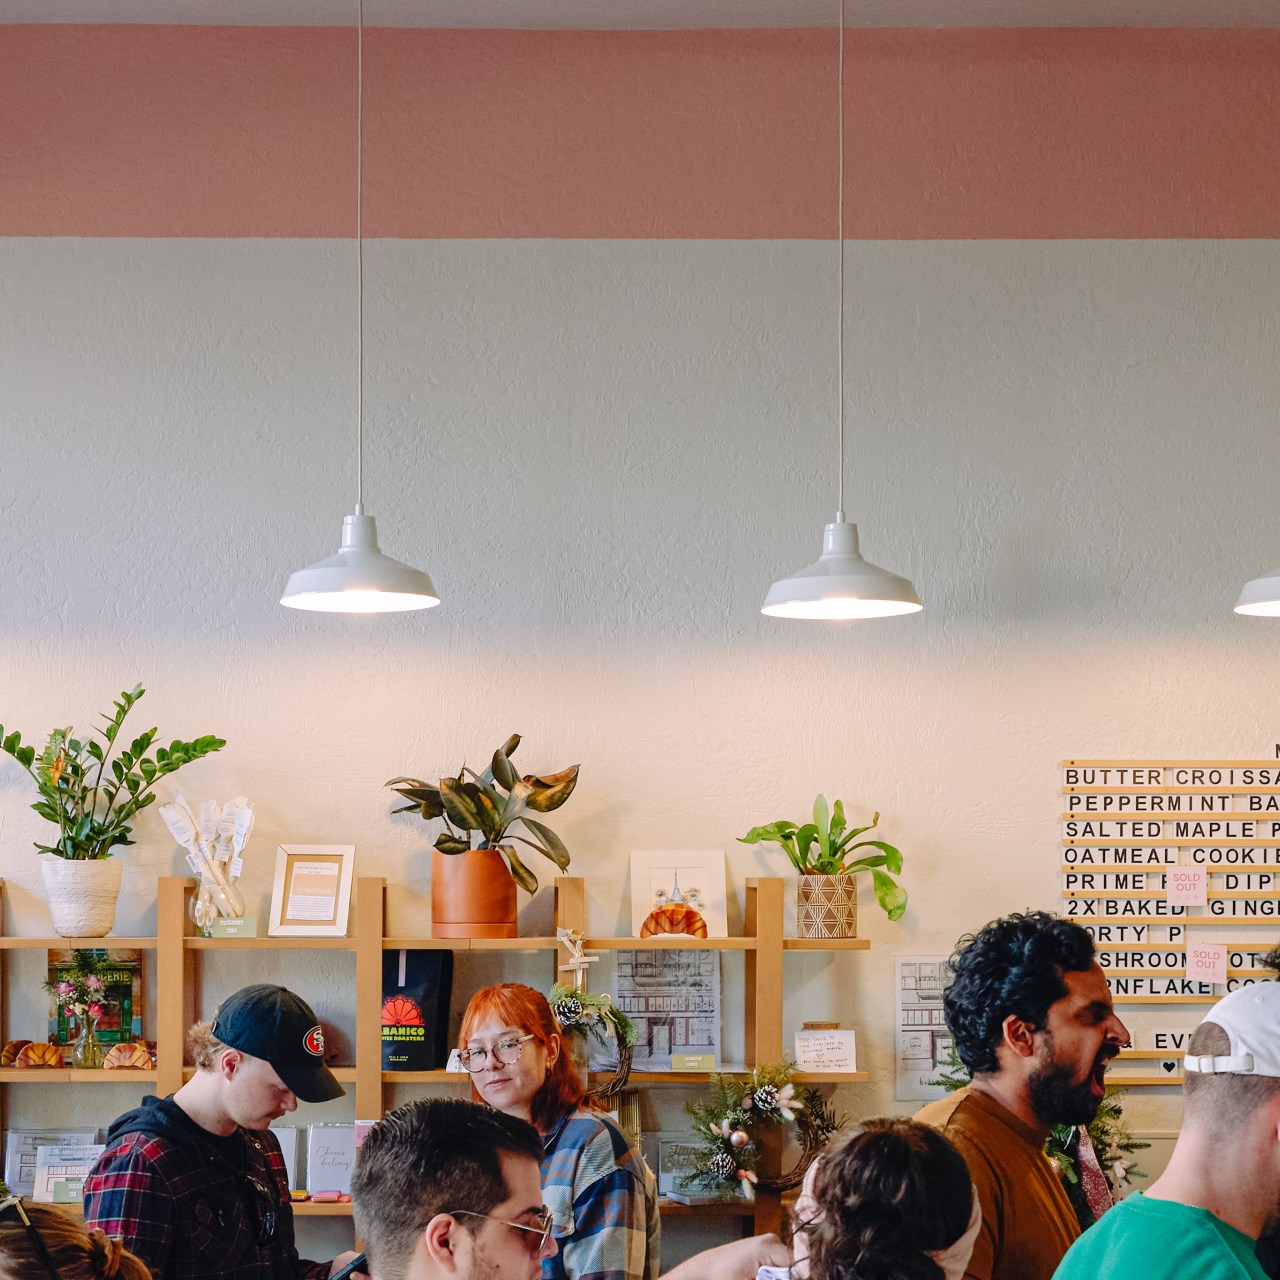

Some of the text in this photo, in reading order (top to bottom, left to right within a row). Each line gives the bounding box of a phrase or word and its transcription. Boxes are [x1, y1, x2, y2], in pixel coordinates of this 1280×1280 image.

[1066, 769, 1161, 785] BUTTER
[1069, 795, 1230, 811] PEPPERMINT
[1066, 821, 1161, 838] SALTED
[1175, 822, 1254, 838] MAPLE
[1064, 848, 1176, 864] OATMEAL
[1066, 873, 1144, 890] PRIME
[1225, 874, 1271, 890] DIP
[1173, 873, 1201, 882] SOLD
[1176, 883, 1197, 892] OUT
[1067, 899, 1096, 916] 2X
[1105, 899, 1185, 916] BAKED
[1169, 926, 1182, 942] P
[1193, 950, 1220, 960] SOLD
[1196, 960, 1217, 970] OUT
[382, 1027, 425, 1036] BANICO
